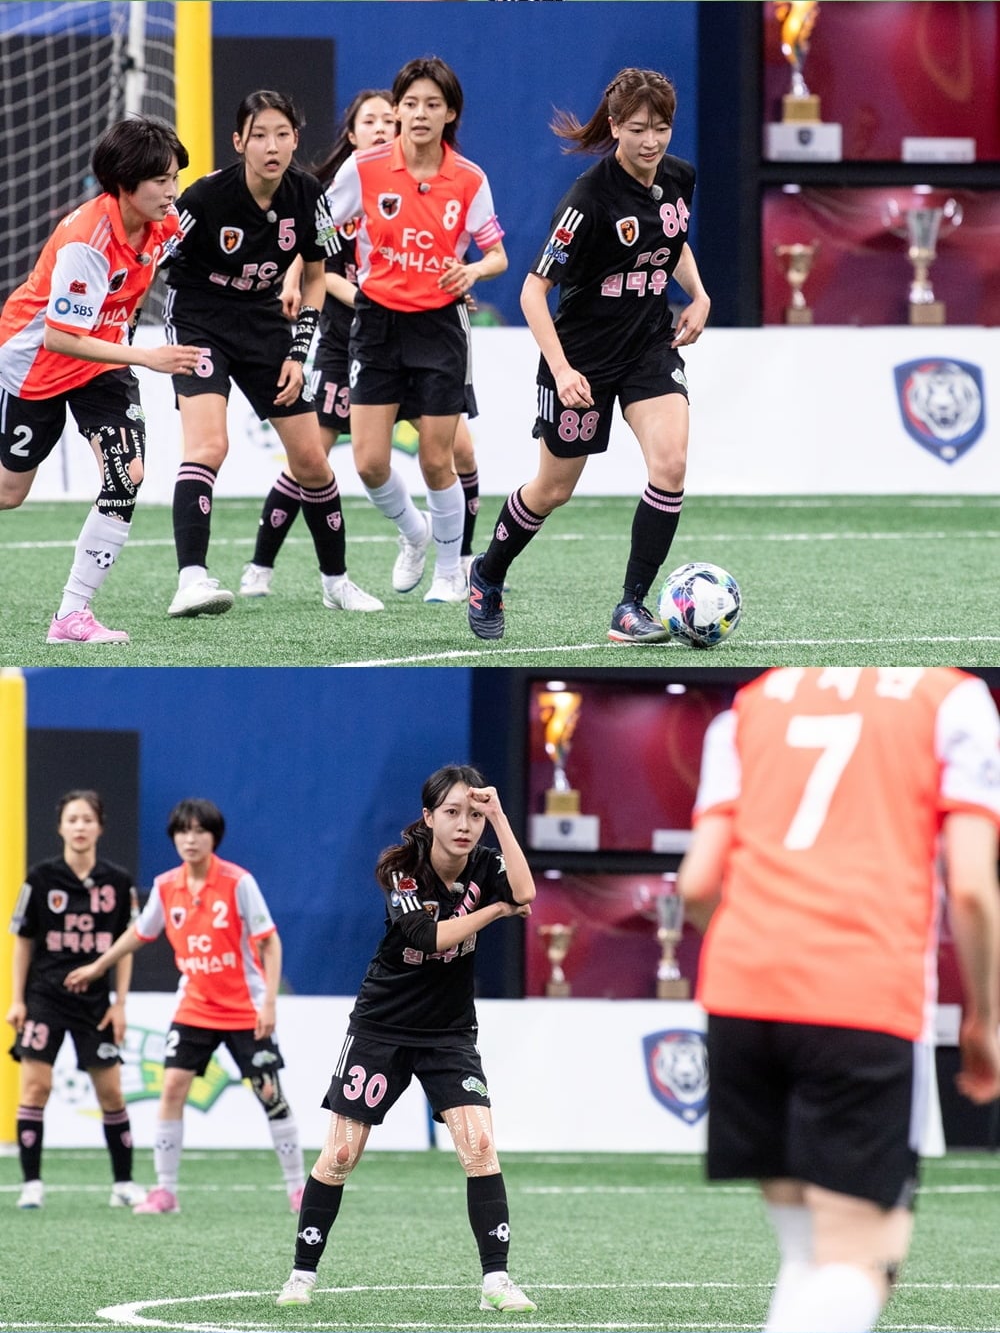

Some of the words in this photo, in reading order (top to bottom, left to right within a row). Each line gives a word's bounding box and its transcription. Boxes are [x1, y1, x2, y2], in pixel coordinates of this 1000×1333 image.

[442, 199, 461, 230] 8
[278, 218, 296, 251] 5
[402, 227, 434, 249] FC
[242, 261, 278, 281] FC
[633, 247, 671, 269] FC
[72, 303, 94, 318] SBS
[195, 348, 214, 378] 5
[349, 360, 361, 389] 8
[323, 382, 350, 418] 13
[558, 409, 600, 442] 88
[10, 425, 33, 457] 2
[784, 712, 864, 851] 7
[88, 884, 116, 914] 13
[212, 899, 229, 929] 2
[64, 913, 95, 932] FC
[187, 934, 213, 953] FC
[21, 1019, 49, 1051] 13
[166, 1029, 180, 1058] 2
[343, 1065, 388, 1108] 30
